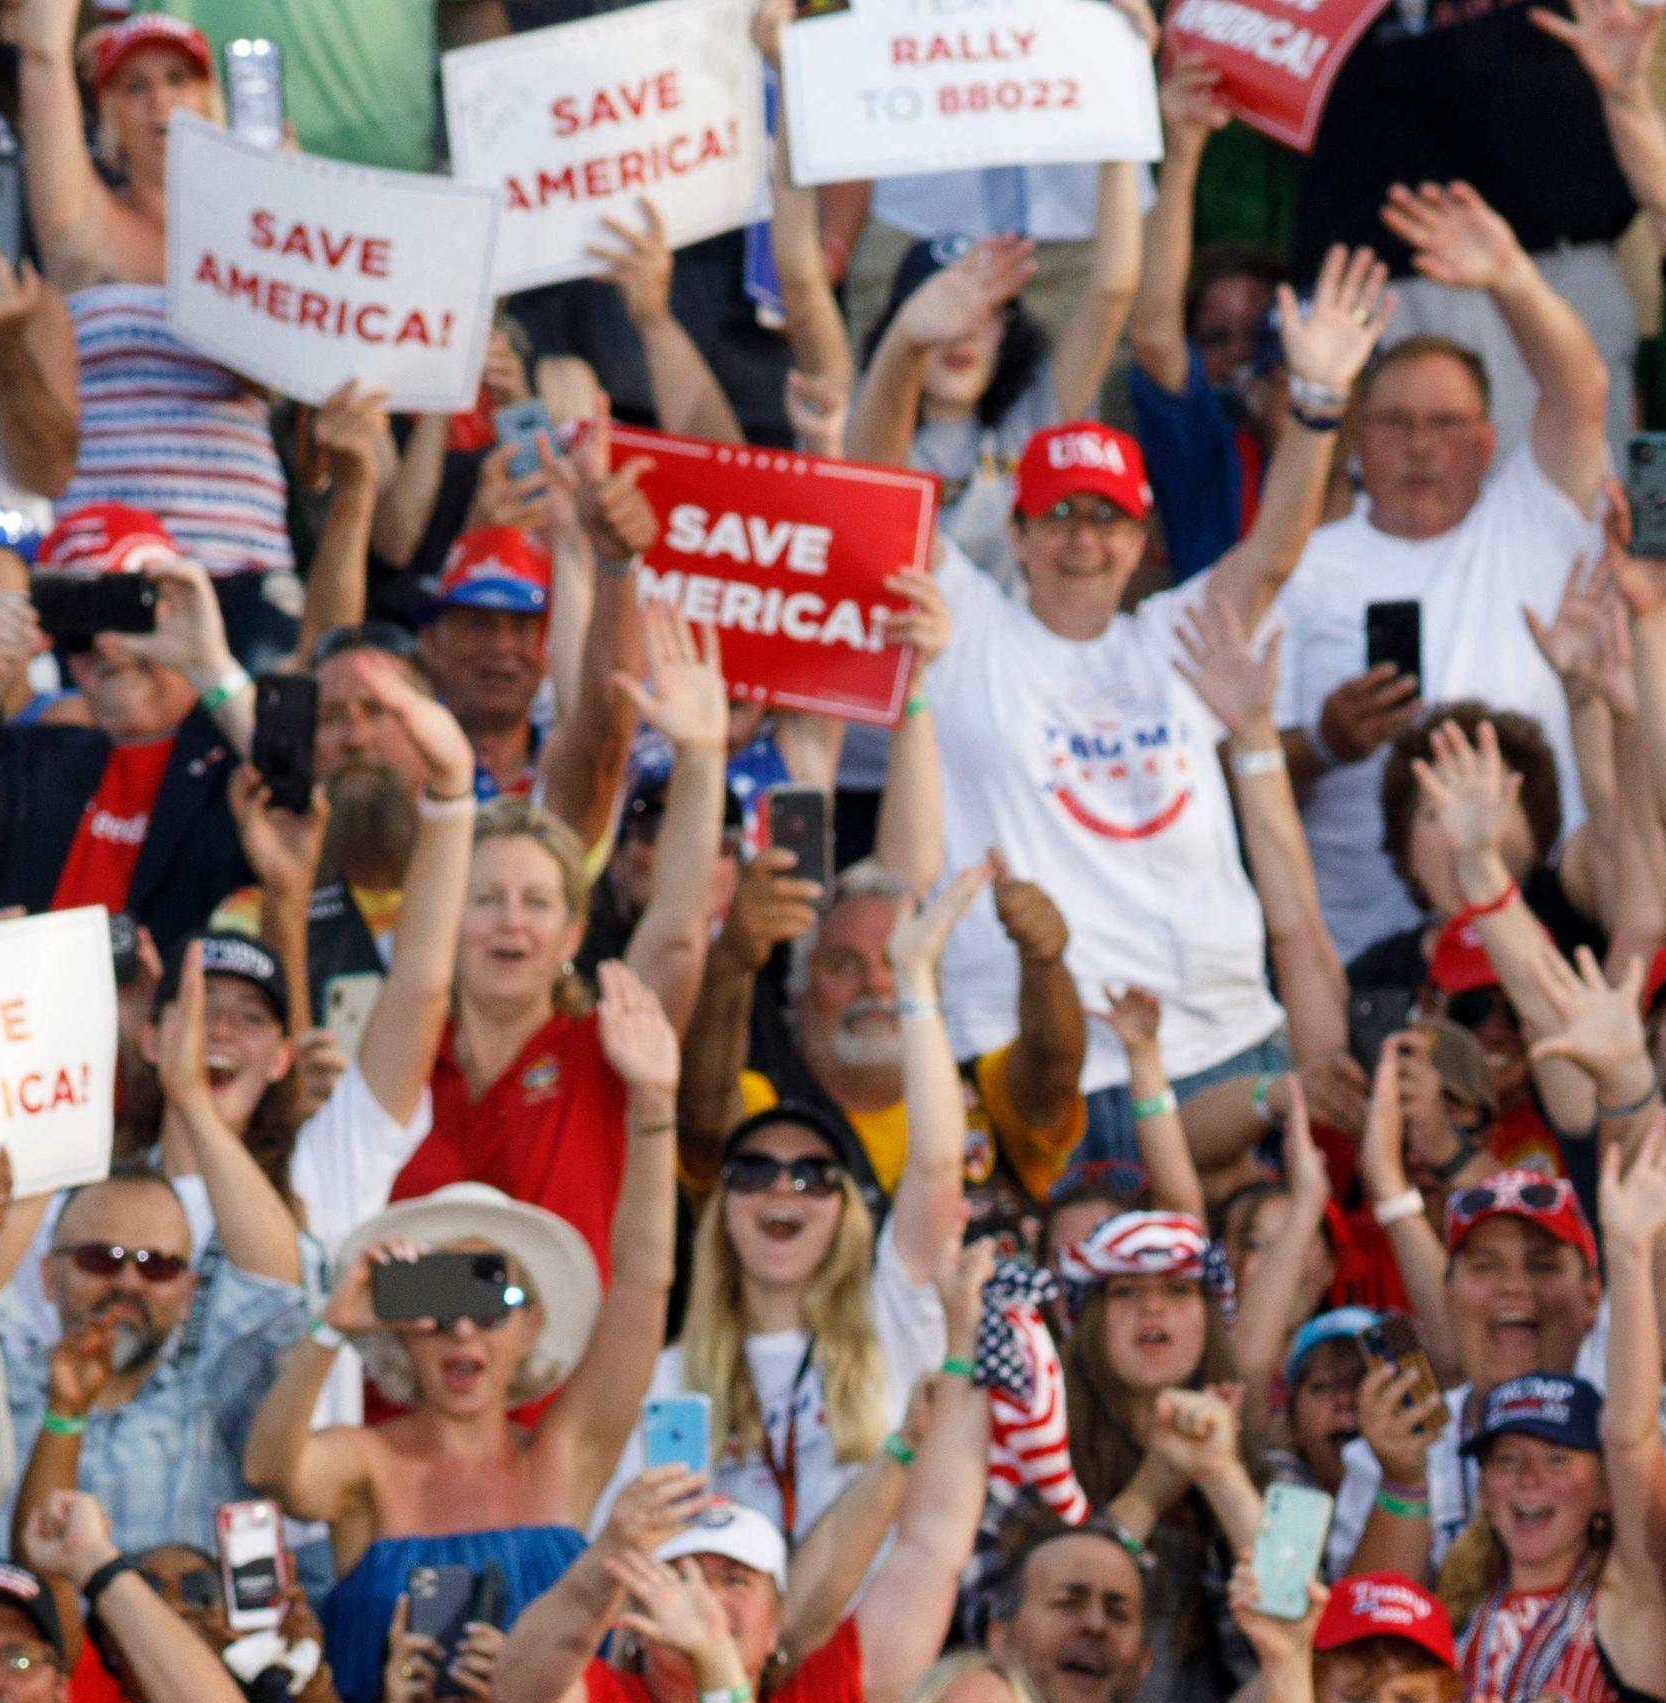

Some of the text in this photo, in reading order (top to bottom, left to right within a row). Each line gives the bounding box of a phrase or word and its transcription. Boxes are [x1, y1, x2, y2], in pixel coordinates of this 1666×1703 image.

[890, 29, 1038, 67] RALLY
[550, 70, 684, 137] SAVE
[860, 78, 1081, 124] TO 88022
[504, 117, 739, 213] AMERICA!
[250, 209, 391, 279] SAVE
[194, 254, 454, 350] AMERICA!
[1048, 435, 1126, 475] USA
[666, 503, 833, 575] SAVE
[637, 564, 890, 653] MERICA!
